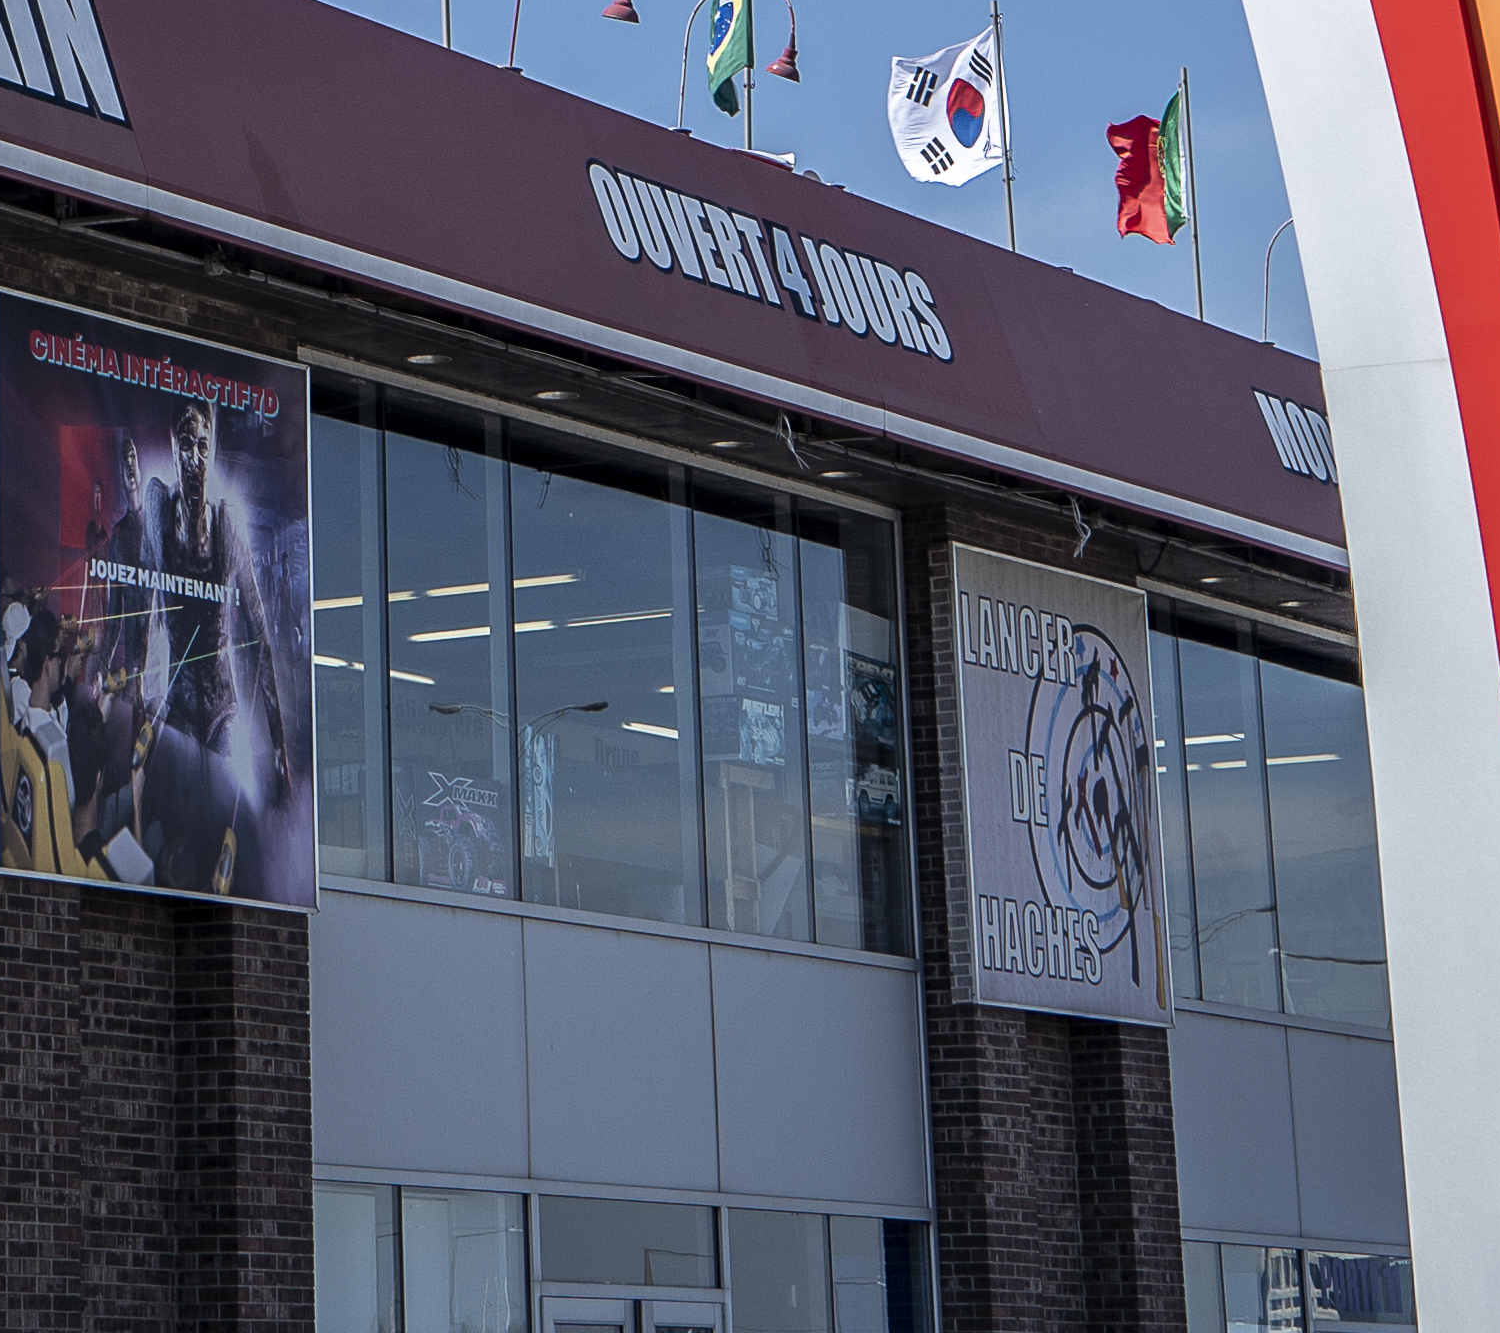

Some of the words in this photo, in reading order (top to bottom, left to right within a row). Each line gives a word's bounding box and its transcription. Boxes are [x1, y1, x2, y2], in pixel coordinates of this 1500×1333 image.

[586, 158, 785, 310] OUVERT
[763, 219, 823, 323] 4
[801, 233, 954, 364] JOURS
[29, 330, 121, 381] CINÉMA
[121, 352, 251, 411] INTÉRACTIF
[251, 386, 280, 418] 7D
[90, 558, 137, 586] JOUEZ
[137, 567, 233, 604] MAINTENANT
[959, 591, 1078, 687] LANCER
[1008, 747, 1050, 828] DE
[979, 894, 1103, 985] HACHES
